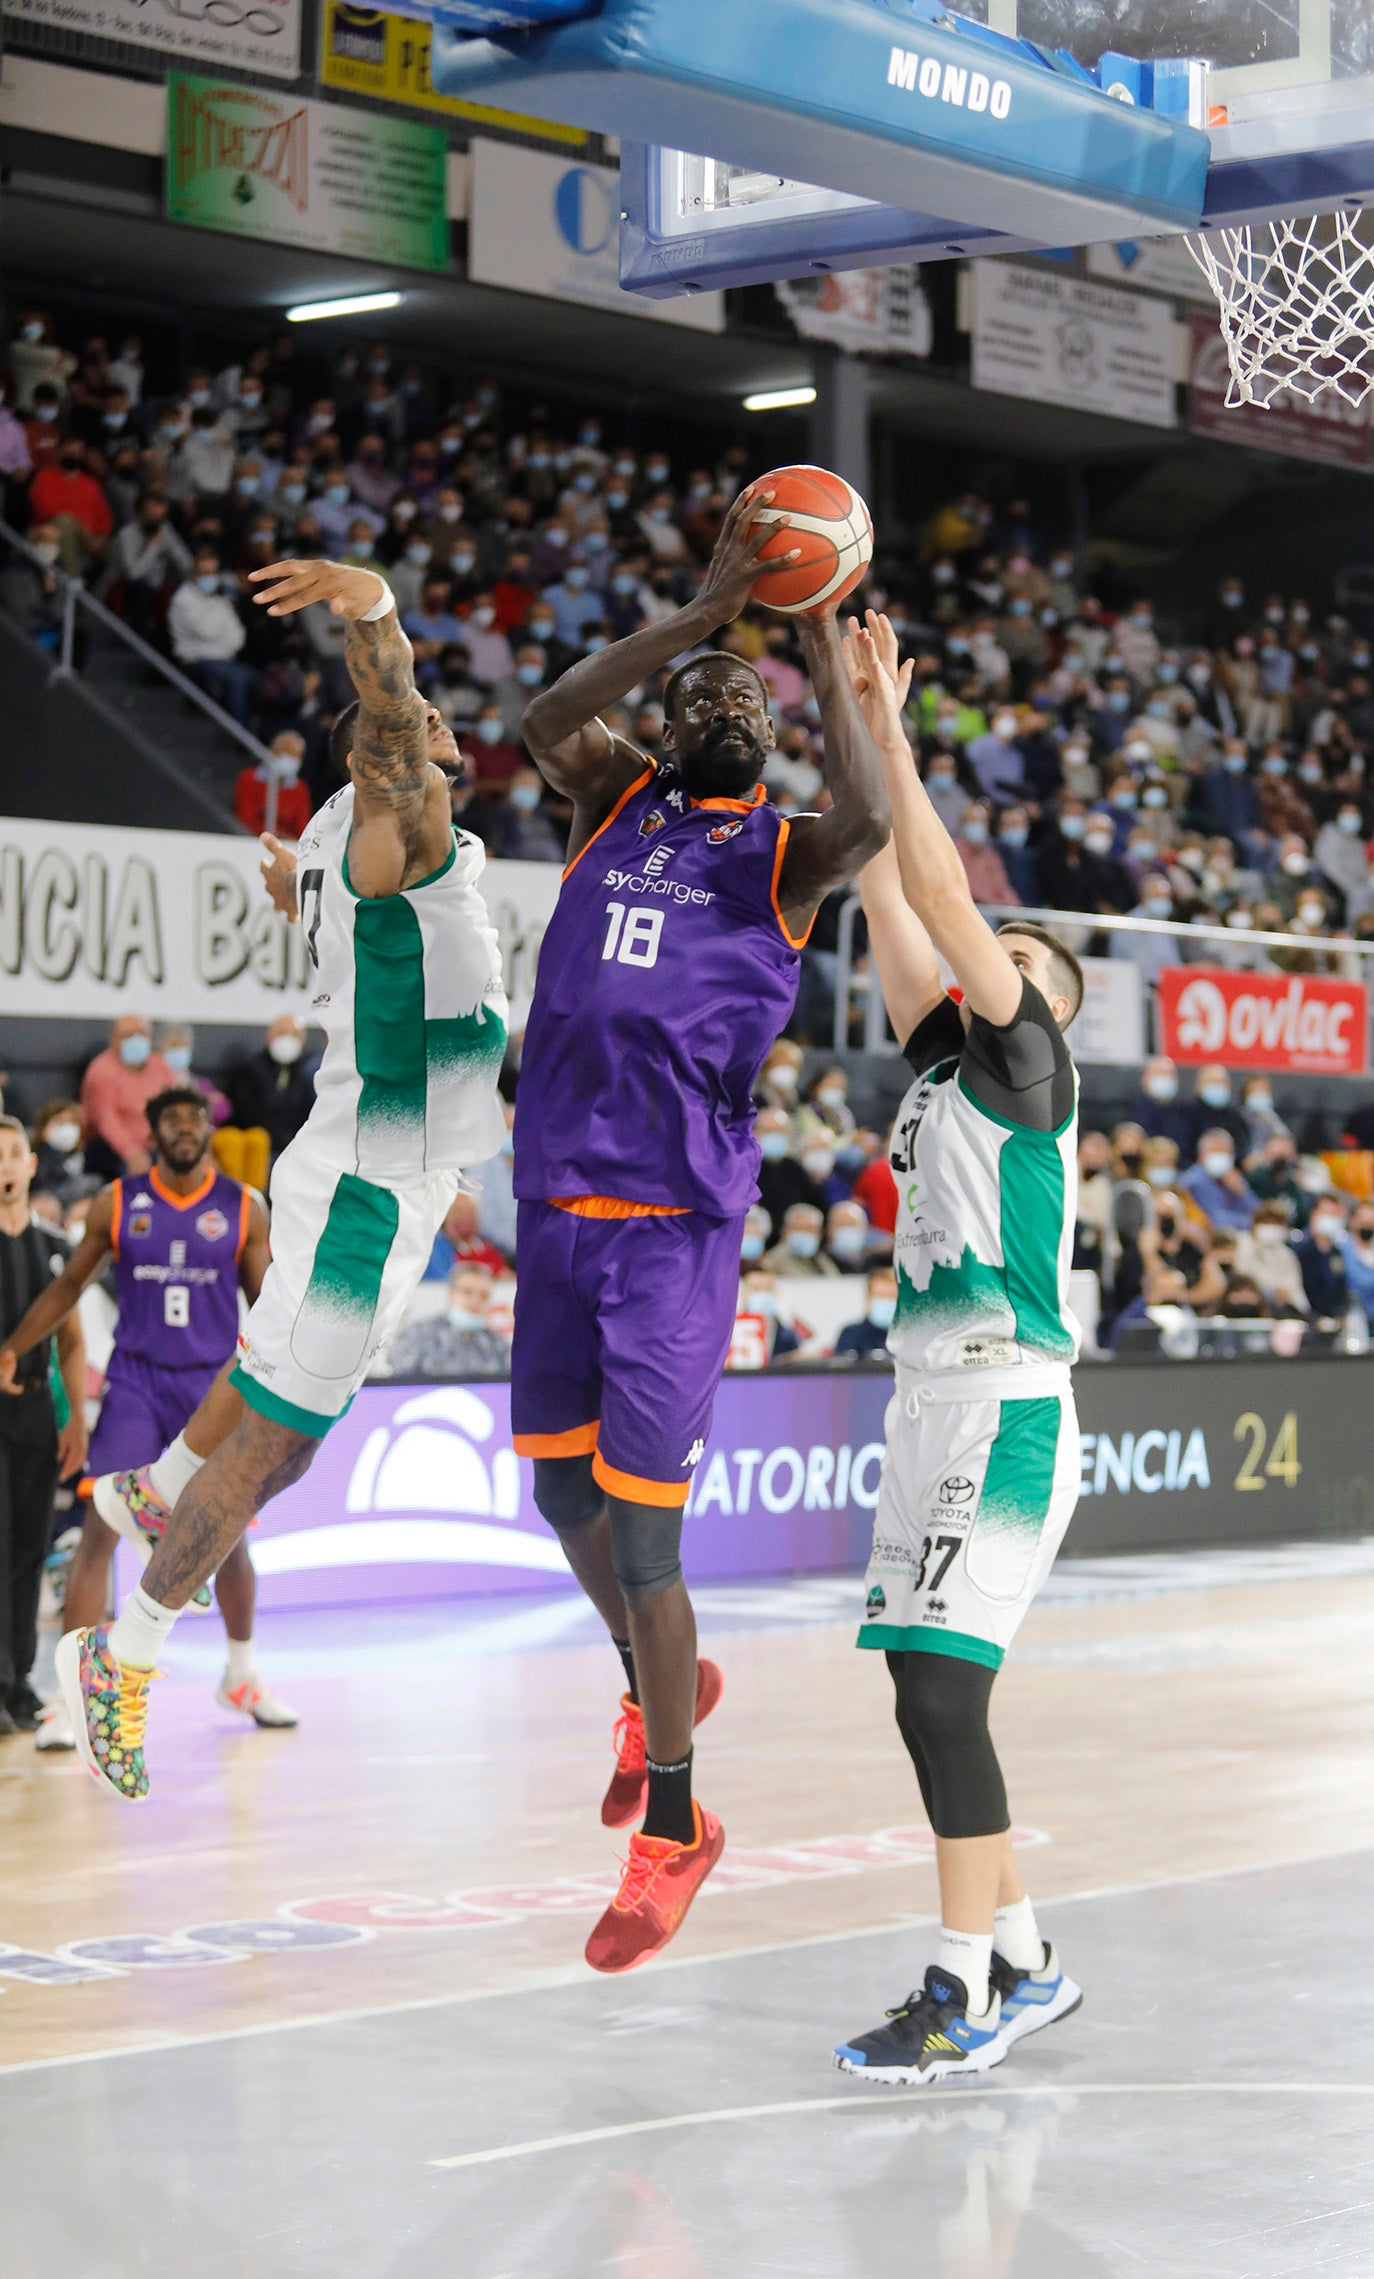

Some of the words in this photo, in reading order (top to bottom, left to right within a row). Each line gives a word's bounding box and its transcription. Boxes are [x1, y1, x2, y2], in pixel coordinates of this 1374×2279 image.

[887, 46, 1012, 120] MONDO
[601, 868, 717, 906] sycharger
[601, 902, 665, 969] 18
[1229, 977, 1354, 1055] ovlac
[164, 1285, 189, 1328] 8
[689, 1442, 885, 1519] ATORIO
[1232, 1411, 1303, 1492] 24
